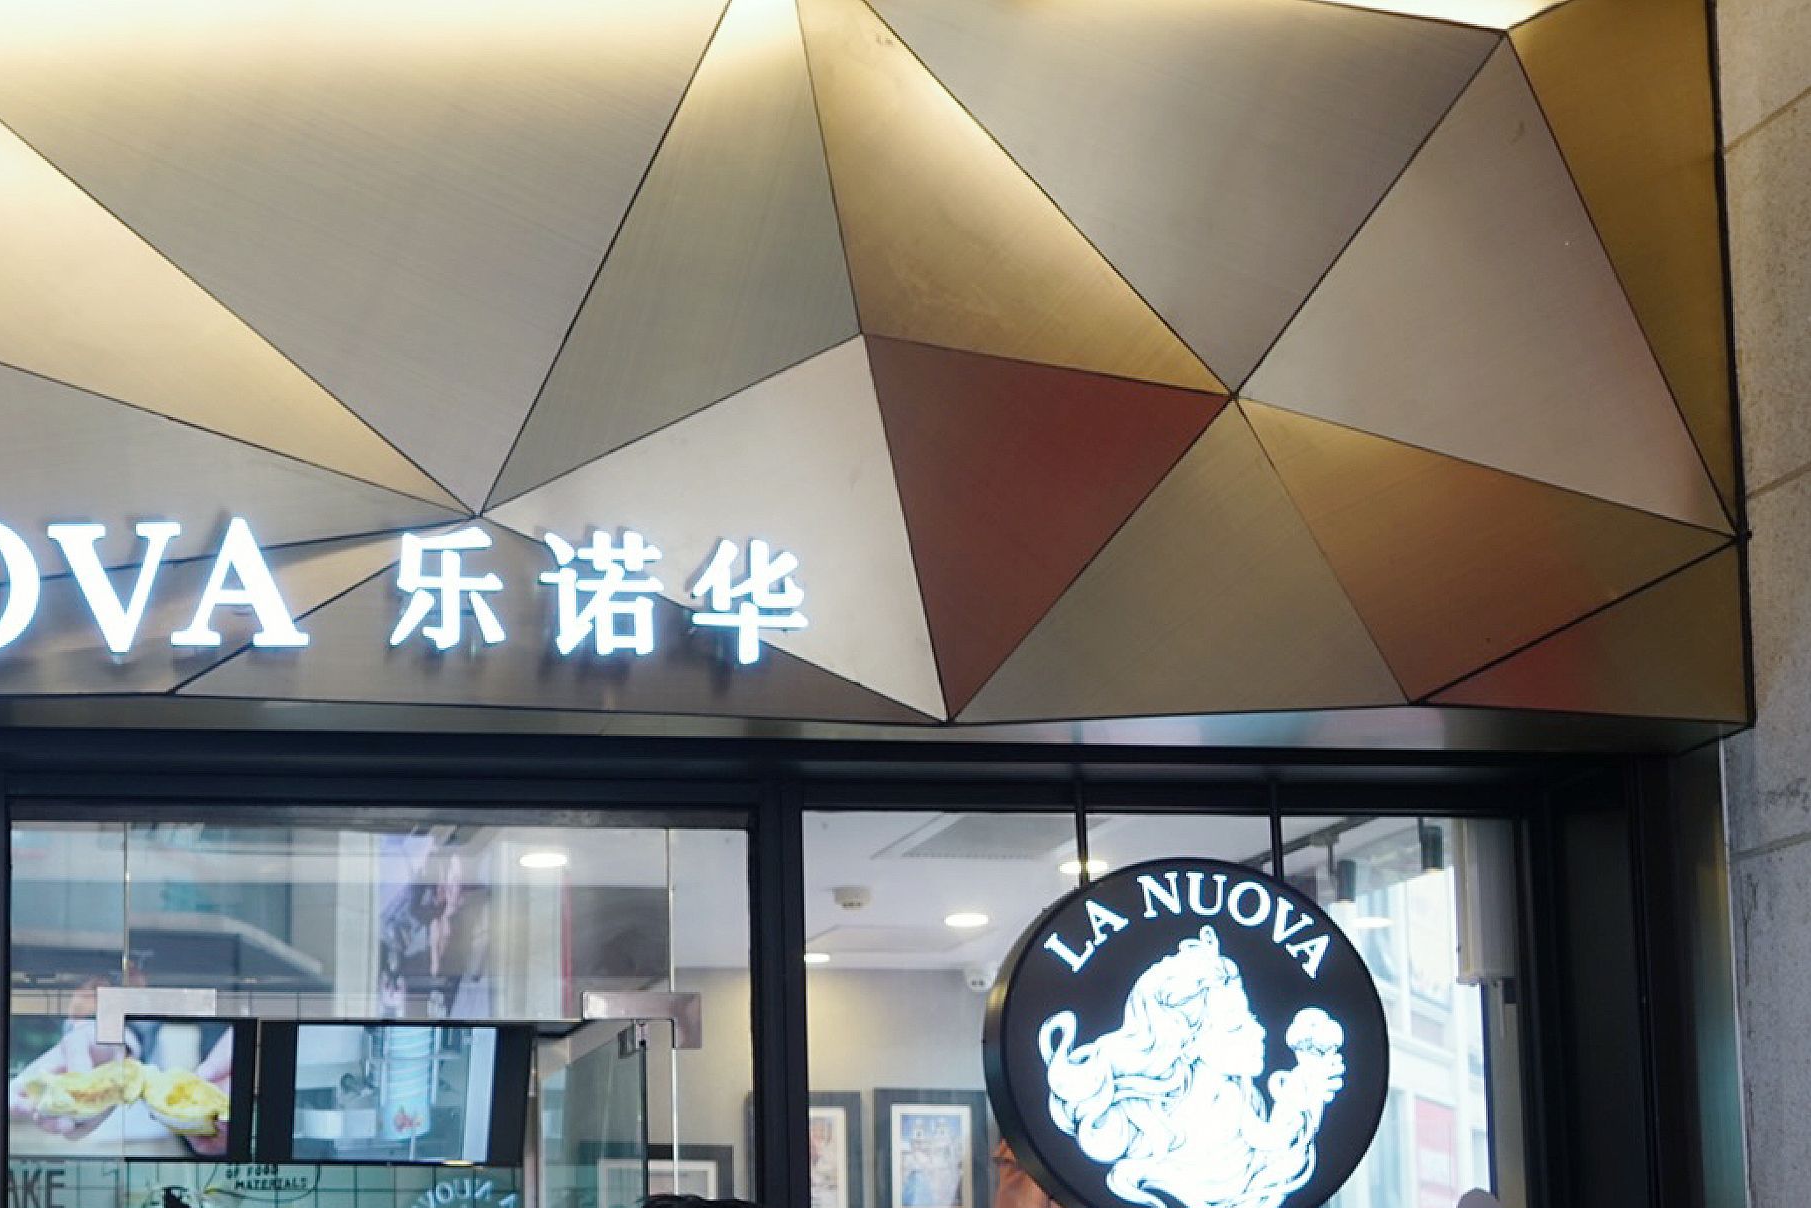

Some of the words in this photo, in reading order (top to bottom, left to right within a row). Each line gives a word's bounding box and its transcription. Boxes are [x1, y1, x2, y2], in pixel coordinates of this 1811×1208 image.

[390, 527, 809, 665] 乐诺华
[1043, 900, 1130, 973] LA
[1137, 871, 1332, 979] NUOVA
